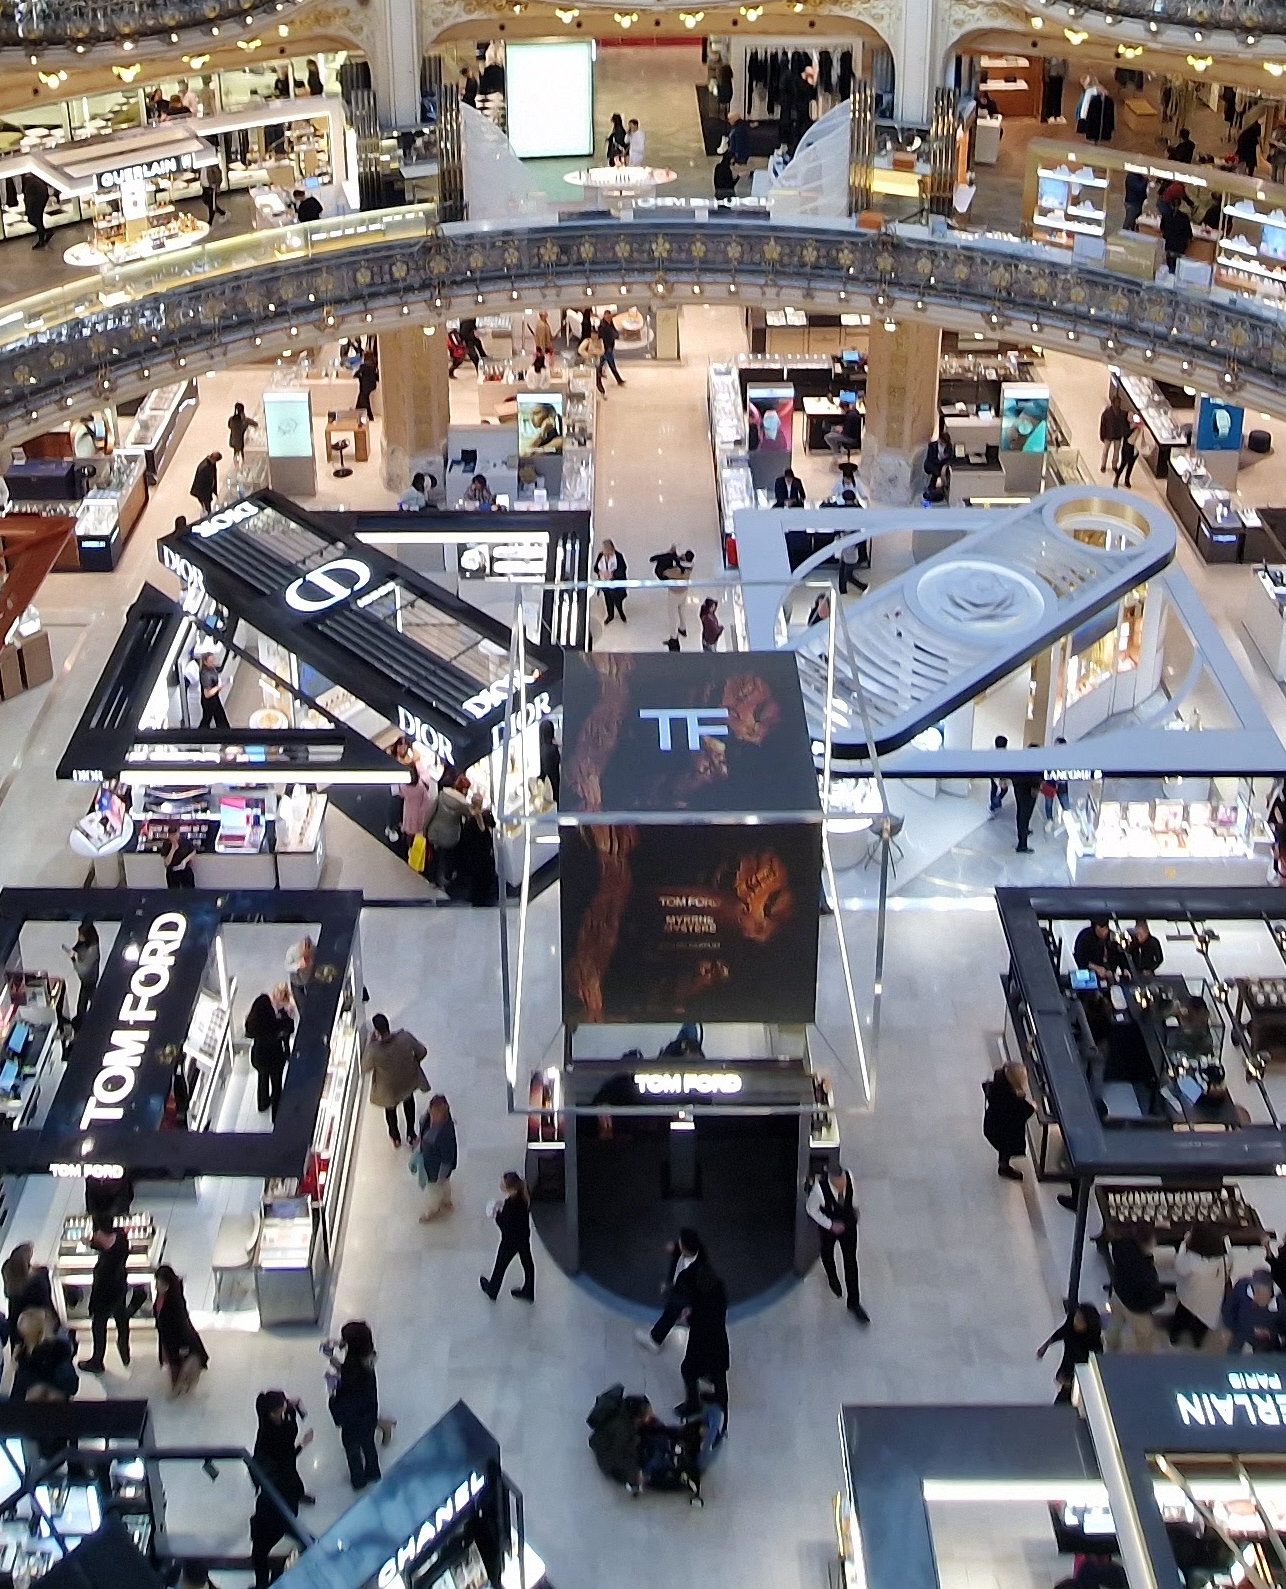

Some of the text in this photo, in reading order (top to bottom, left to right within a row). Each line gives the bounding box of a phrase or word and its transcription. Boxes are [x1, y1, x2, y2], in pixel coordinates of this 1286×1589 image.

[397, 704, 456, 767] DIOR
[491, 691, 552, 751] DIOR
[639, 708, 729, 751] TF
[659, 895, 687, 908] TOM
[79, 911, 188, 1132] TOM FORD
[634, 1073, 743, 1094] TOM FORD
[49, 1163, 125, 1179] TOM FORD
[377, 1470, 486, 1589] CHANEL
